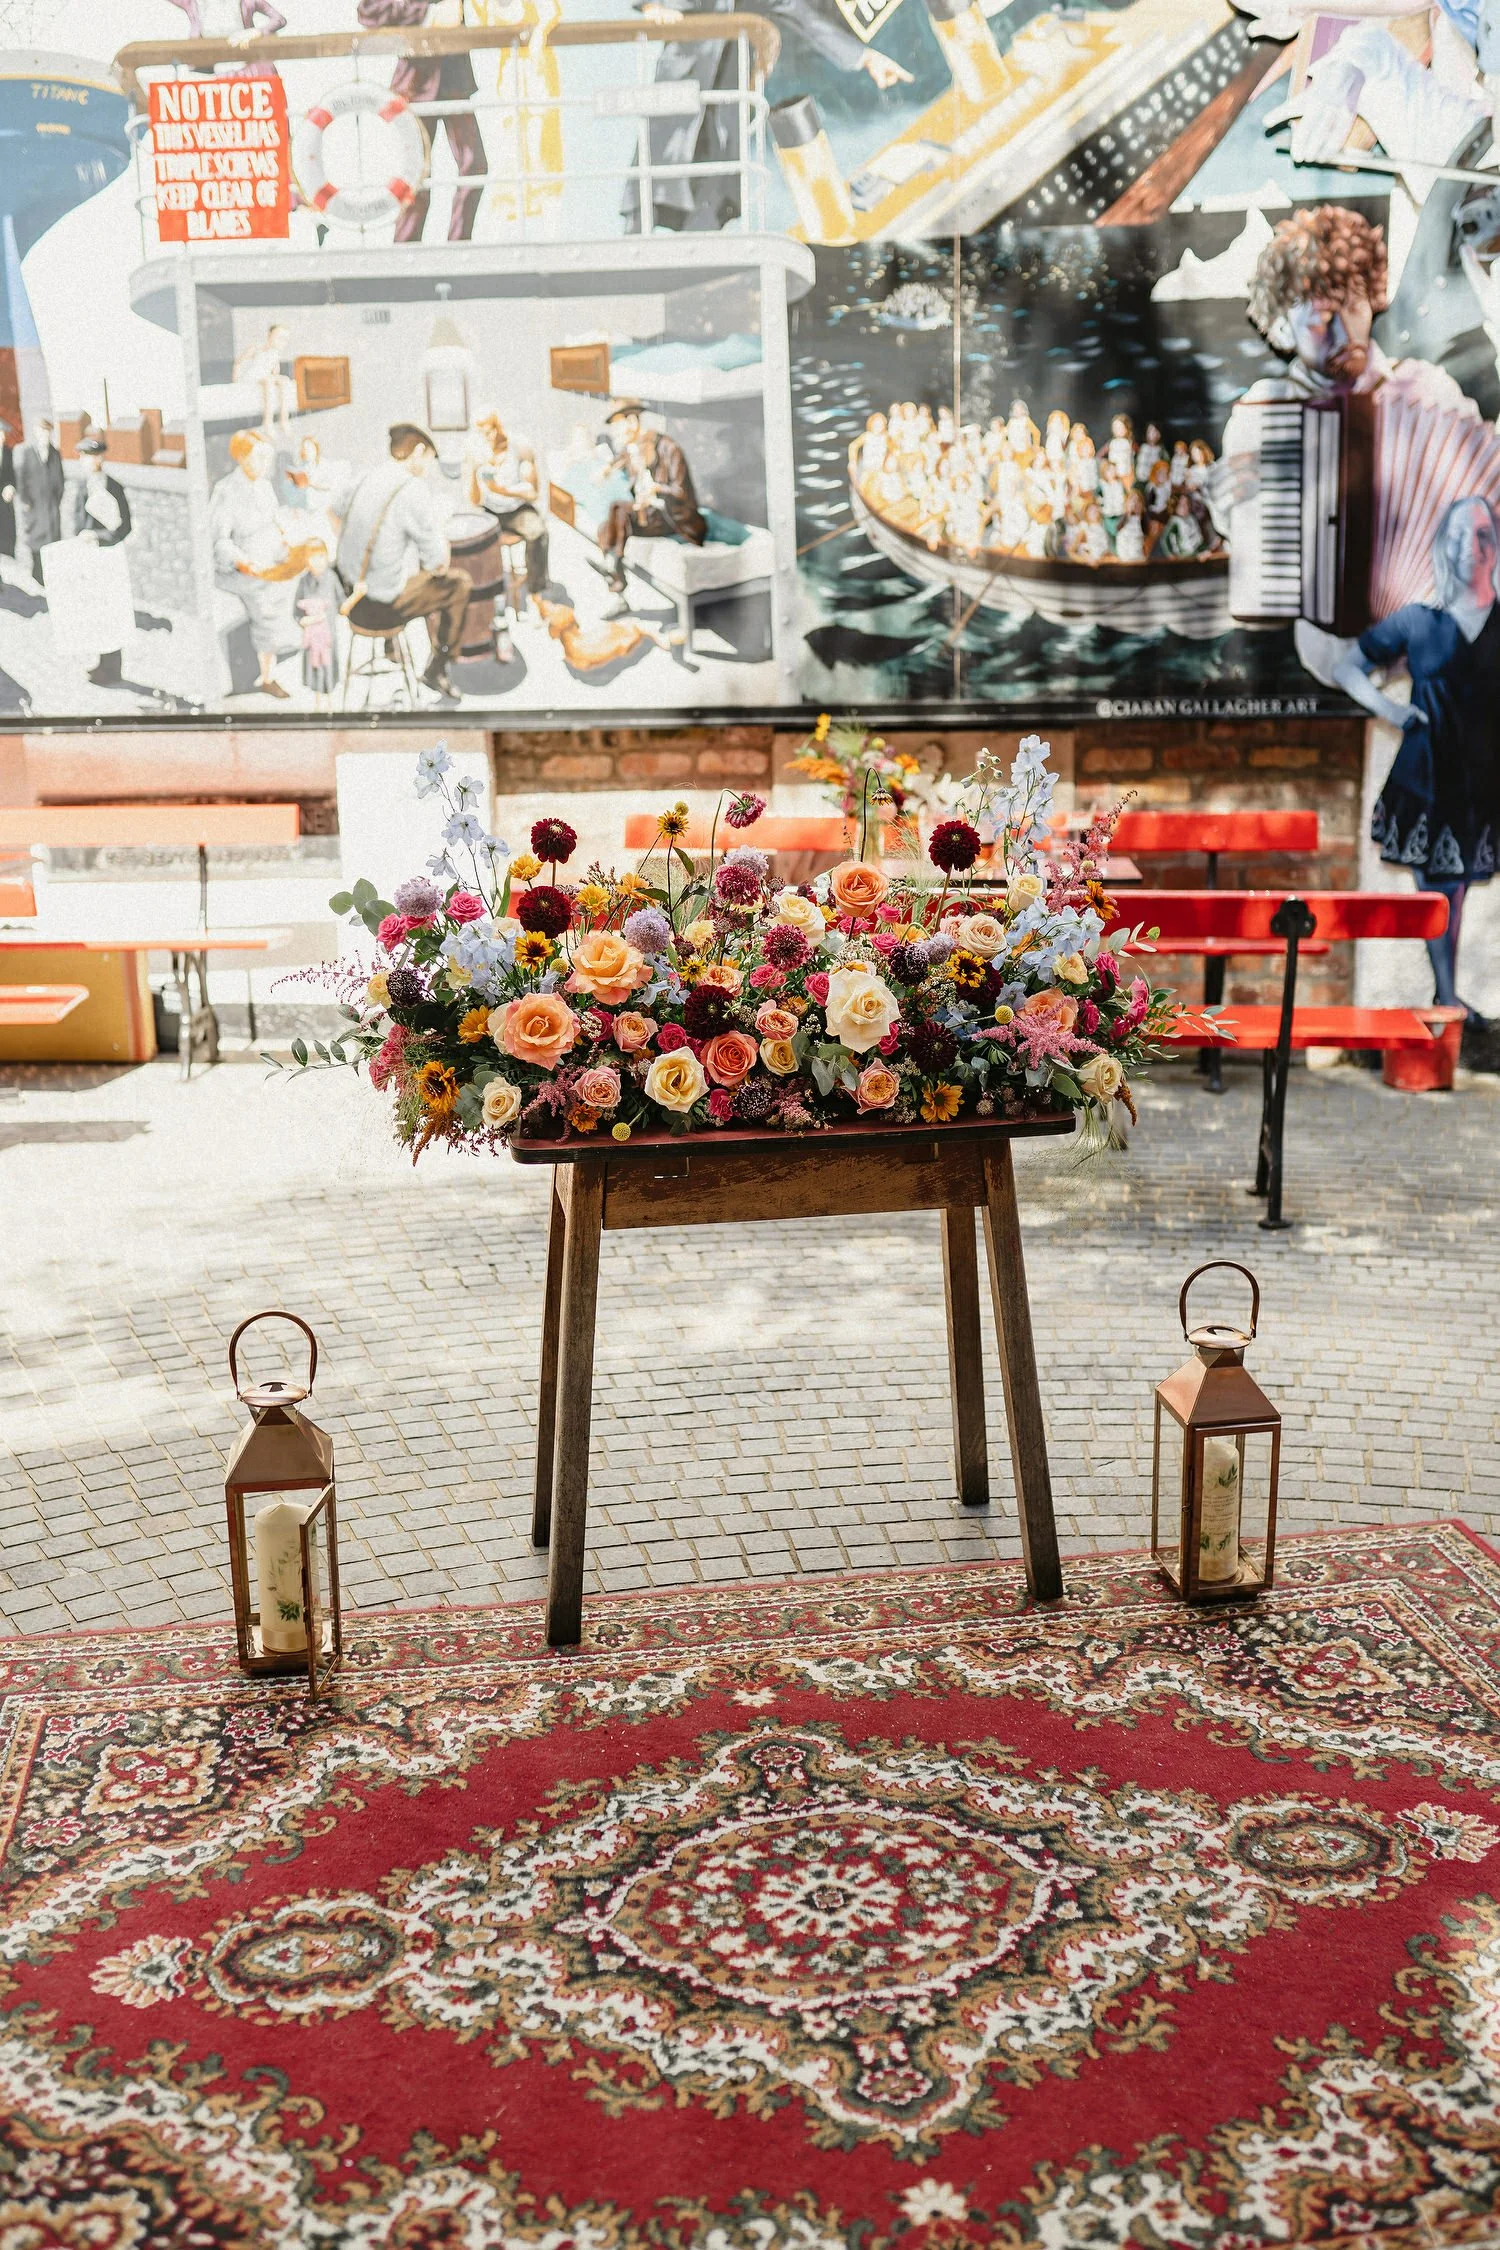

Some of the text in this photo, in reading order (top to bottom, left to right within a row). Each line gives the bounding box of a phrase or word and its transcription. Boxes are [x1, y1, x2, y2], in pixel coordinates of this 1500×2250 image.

[157, 82, 274, 122] NOTICE
[153, 119, 281, 151] THIS VESSEL HAS
[154, 150, 280, 182] TRIPLE SCREWS
[157, 180, 279, 212] KEEP CLEAR OF
[186, 209, 252, 239] BLADES
[1179, 697, 1282, 716] GALLAGHER
[1287, 697, 1317, 714] ART
